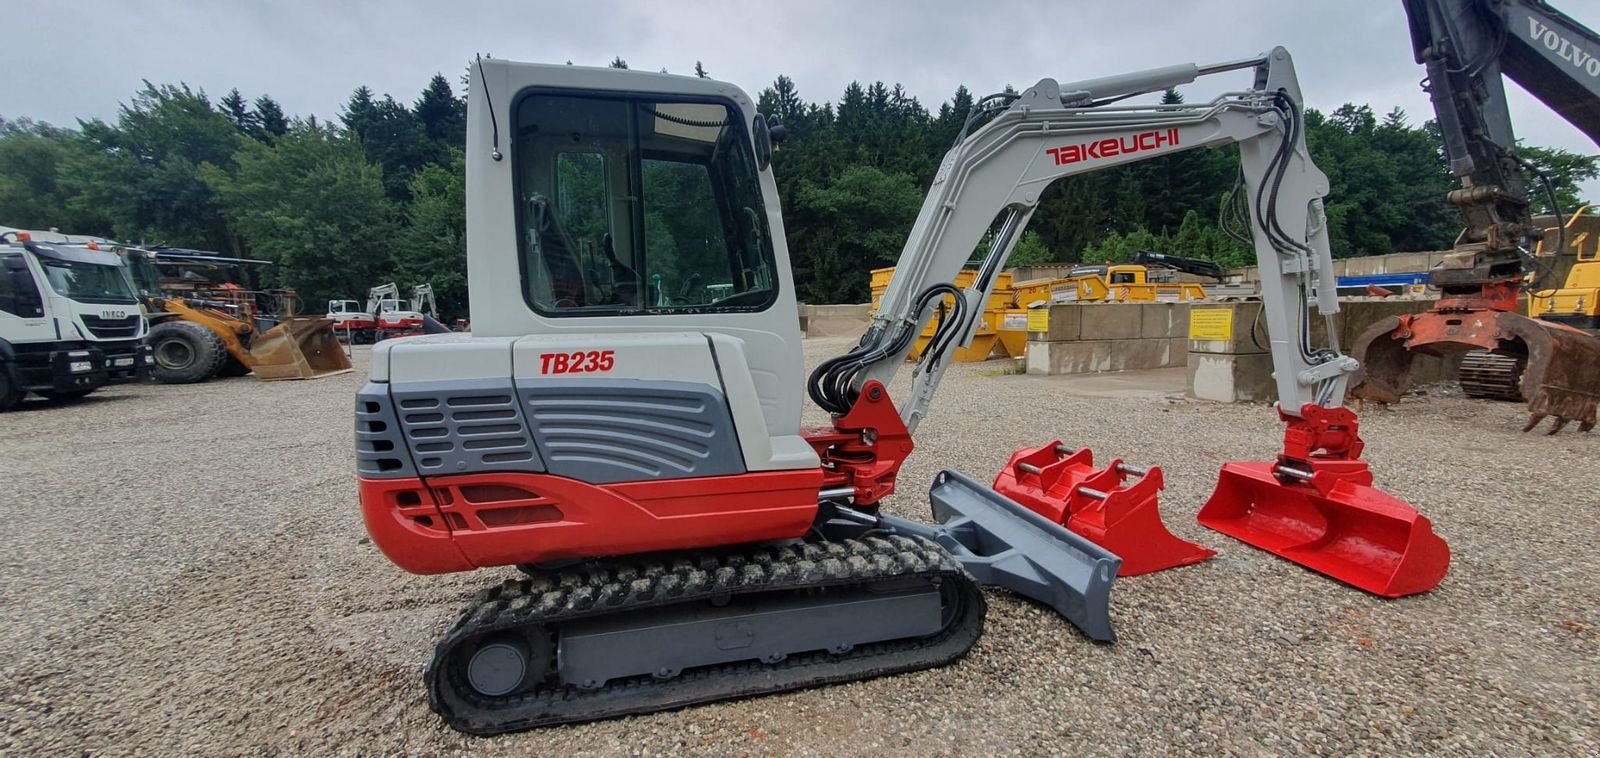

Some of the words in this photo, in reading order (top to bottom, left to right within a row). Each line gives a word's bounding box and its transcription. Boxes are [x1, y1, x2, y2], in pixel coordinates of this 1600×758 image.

[1528, 16, 1600, 77] VOLVO
[1045, 127, 1179, 166] TAKEUCHI
[102, 310, 126, 318] IVECO
[540, 350, 615, 375] TB235
